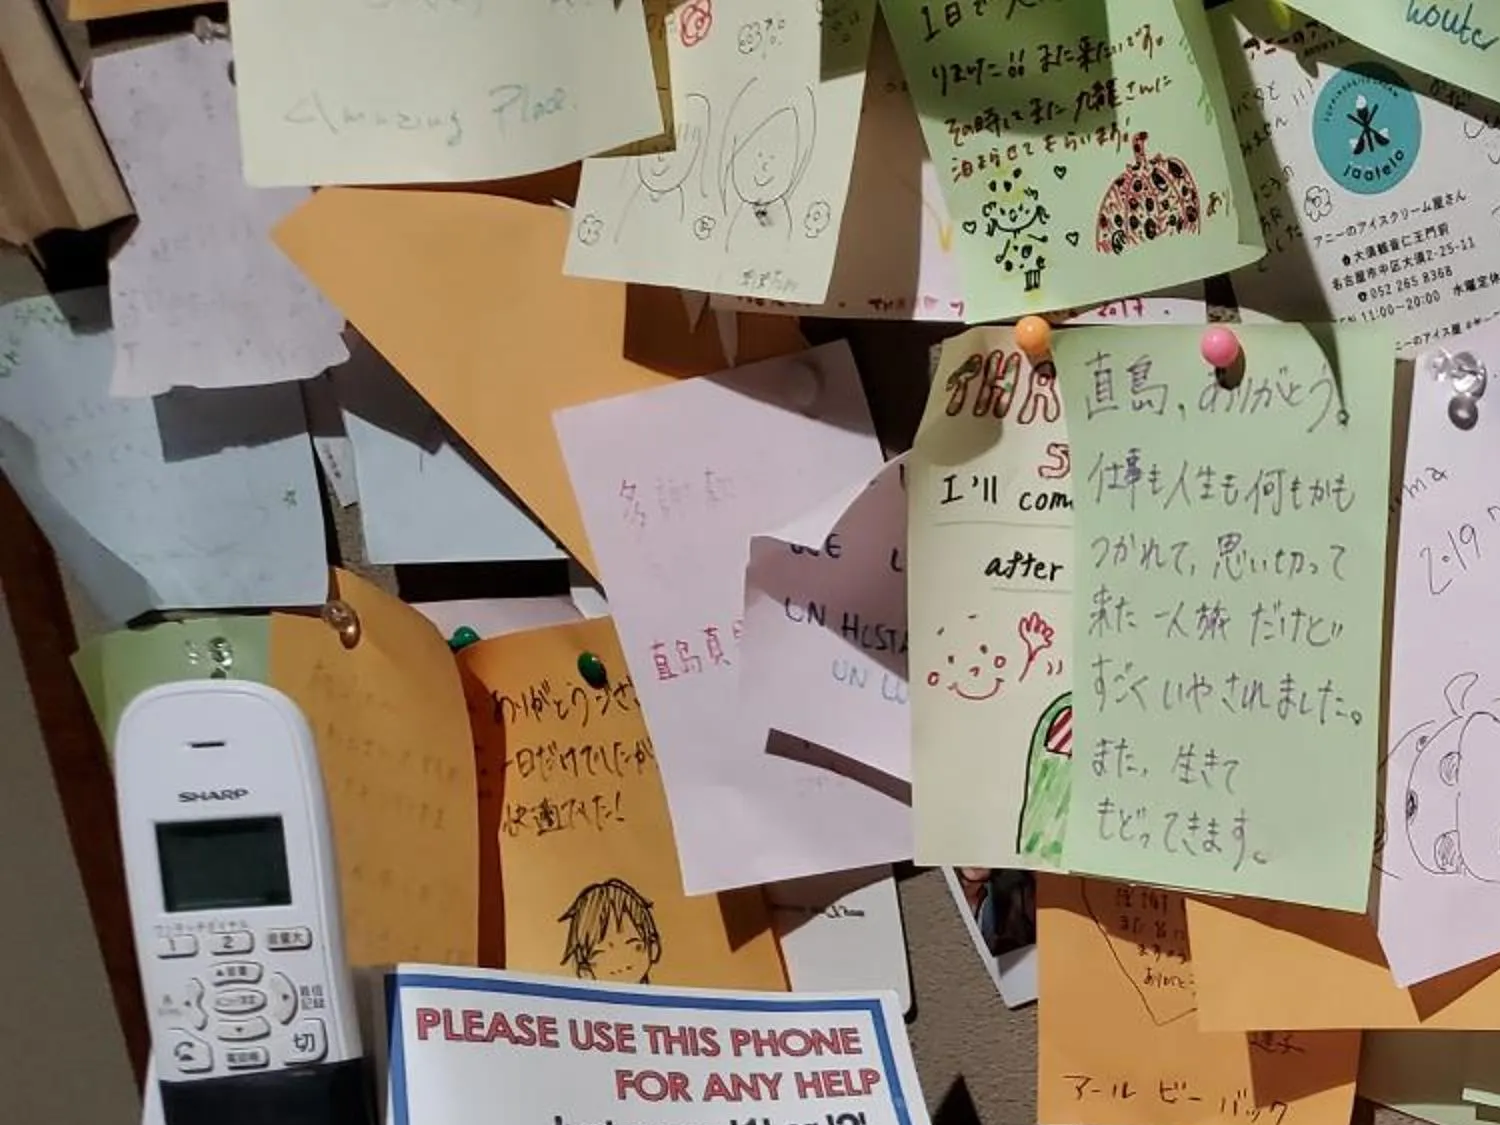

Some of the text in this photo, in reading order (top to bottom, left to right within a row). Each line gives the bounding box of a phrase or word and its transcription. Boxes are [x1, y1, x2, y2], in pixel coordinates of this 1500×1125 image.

[1018, 490, 1074, 512] com
[983, 550, 1064, 582] after
[178, 789, 249, 803] SHARP
[416, 1008, 862, 1057] PLEASE USE THIS PHONE
[615, 1068, 881, 1102] FOR ANY HELP
